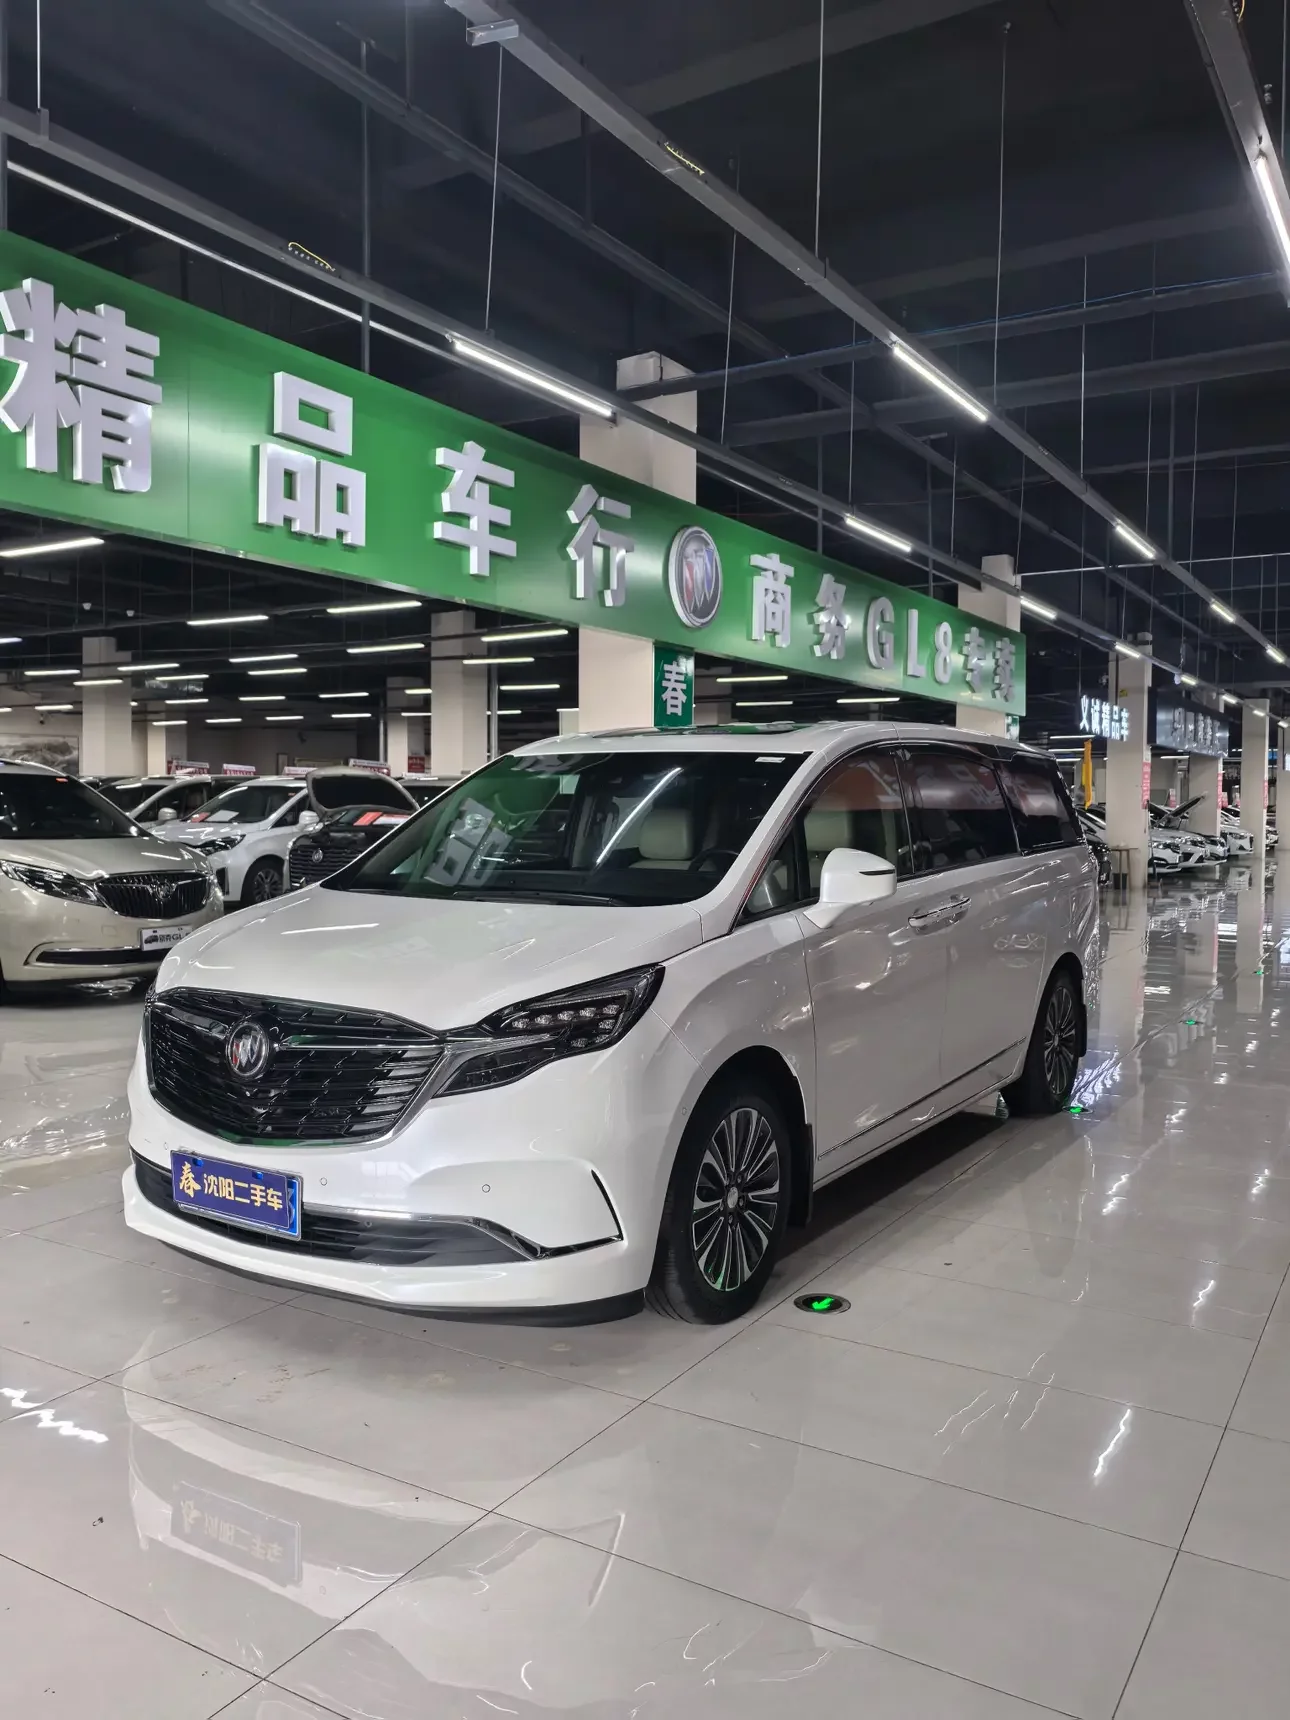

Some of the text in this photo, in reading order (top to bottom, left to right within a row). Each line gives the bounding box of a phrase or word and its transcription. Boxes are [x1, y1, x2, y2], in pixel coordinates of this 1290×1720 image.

[0, 278, 1015, 701] 精品车行 商务GL8专卖
[661, 661, 687, 716] 春
[204, 1173, 283, 1211] 沈阳二手车
